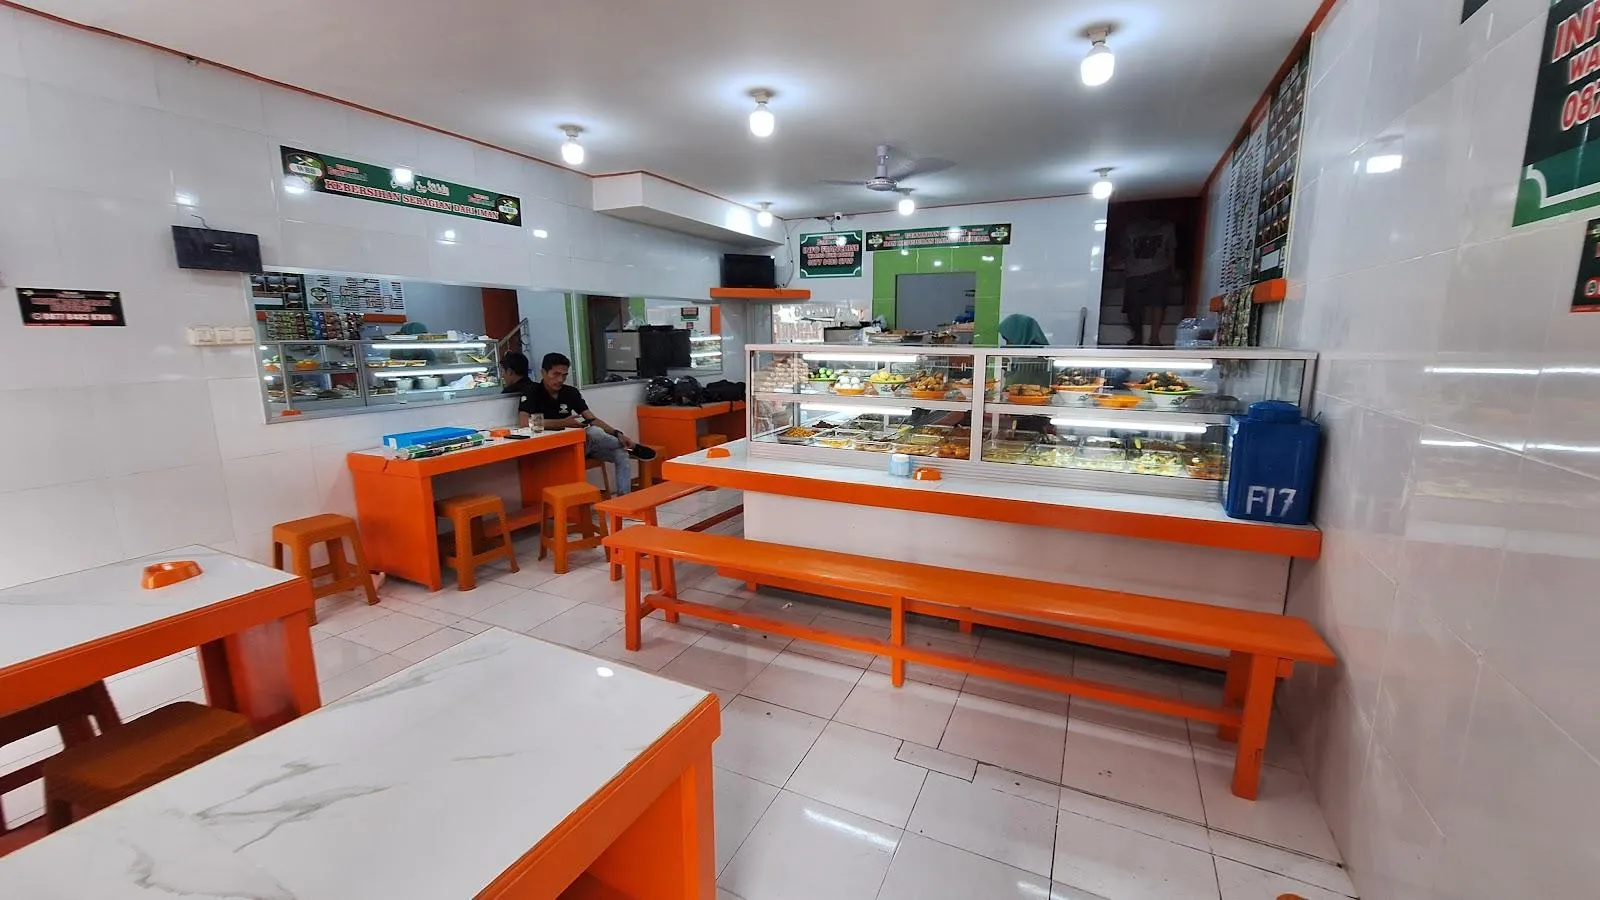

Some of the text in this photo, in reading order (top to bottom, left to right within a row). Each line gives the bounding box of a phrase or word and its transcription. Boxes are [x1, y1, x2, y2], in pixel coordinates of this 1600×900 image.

[324, 179, 401, 202] KEBERSIHAN
[402, 194, 452, 212] SEBAGIAN
[453, 203, 476, 216] DARI
[476, 207, 500, 220] IMAN
[1245, 485, 1297, 517] F17
